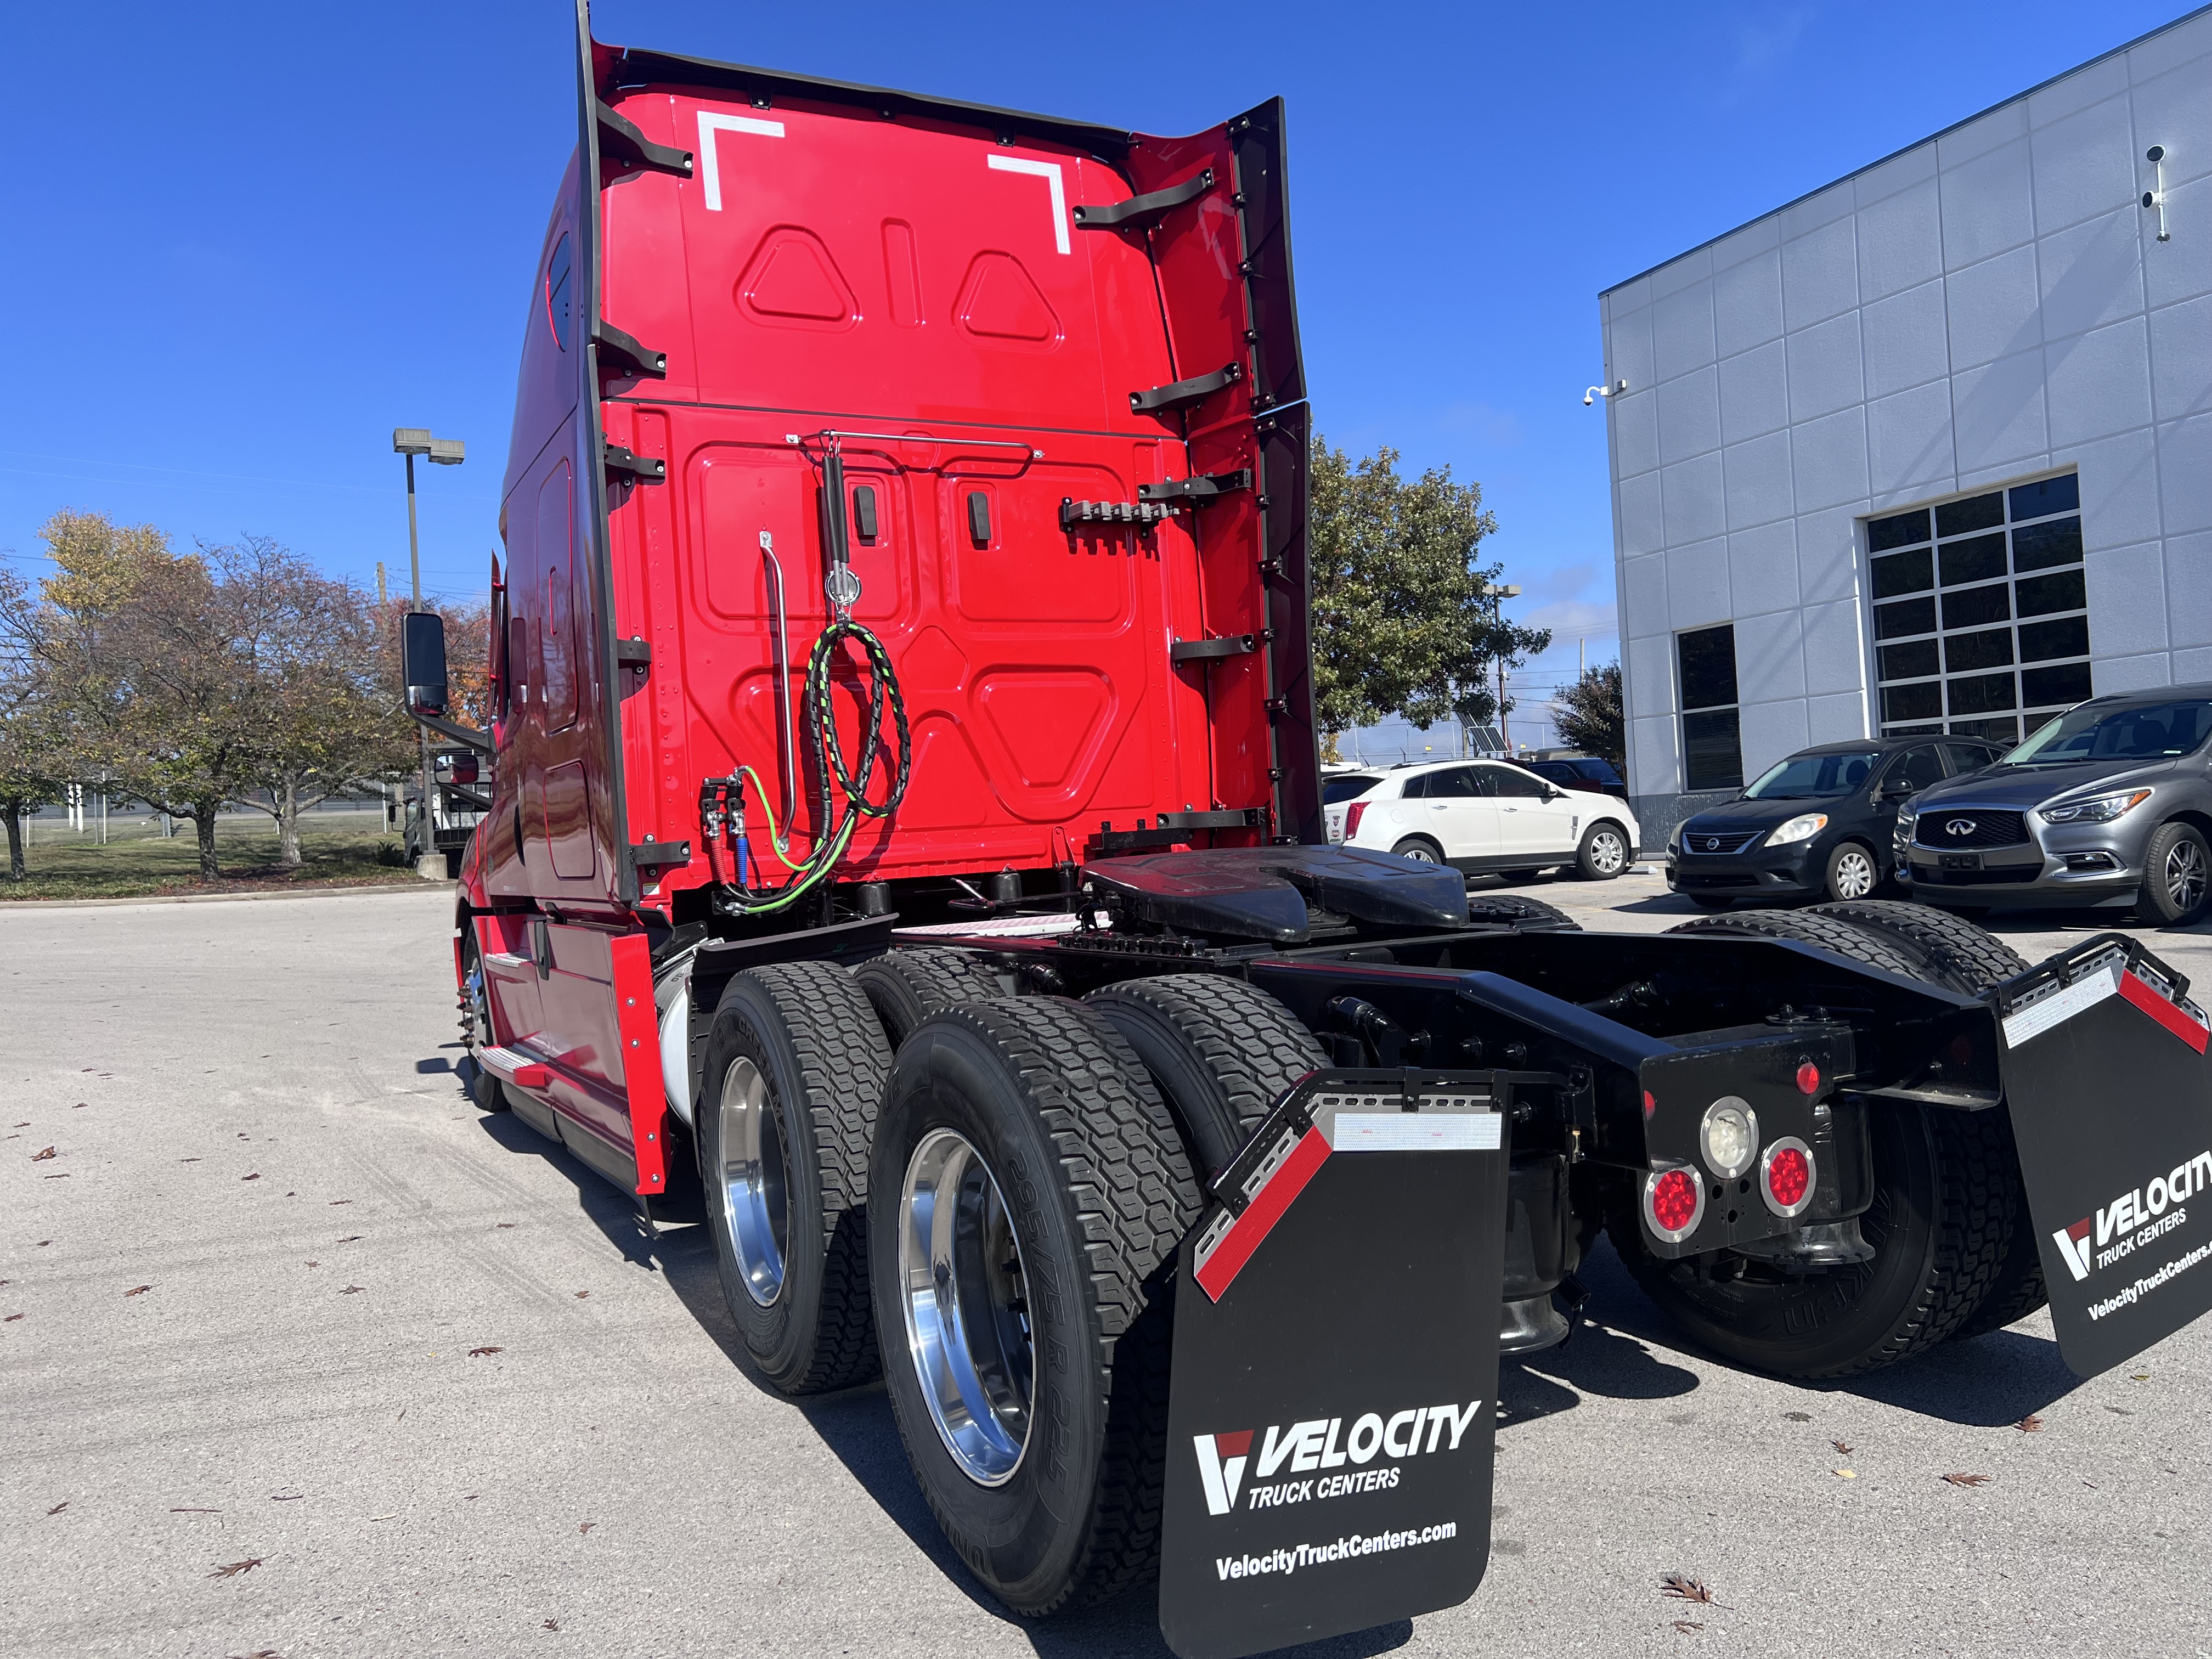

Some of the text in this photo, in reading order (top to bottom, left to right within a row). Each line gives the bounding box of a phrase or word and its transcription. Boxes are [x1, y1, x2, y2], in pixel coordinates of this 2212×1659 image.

[1007, 1150, 1065, 1325] 295/75
[2096, 1207, 2186, 1269] TRUCK CENTERS
[1256, 1400, 1482, 1478] VELOCITY
[1249, 1467, 1401, 1510] TRUCK CENTERS
[1216, 1521, 1457, 1581] VelocityTruckCenters.com
